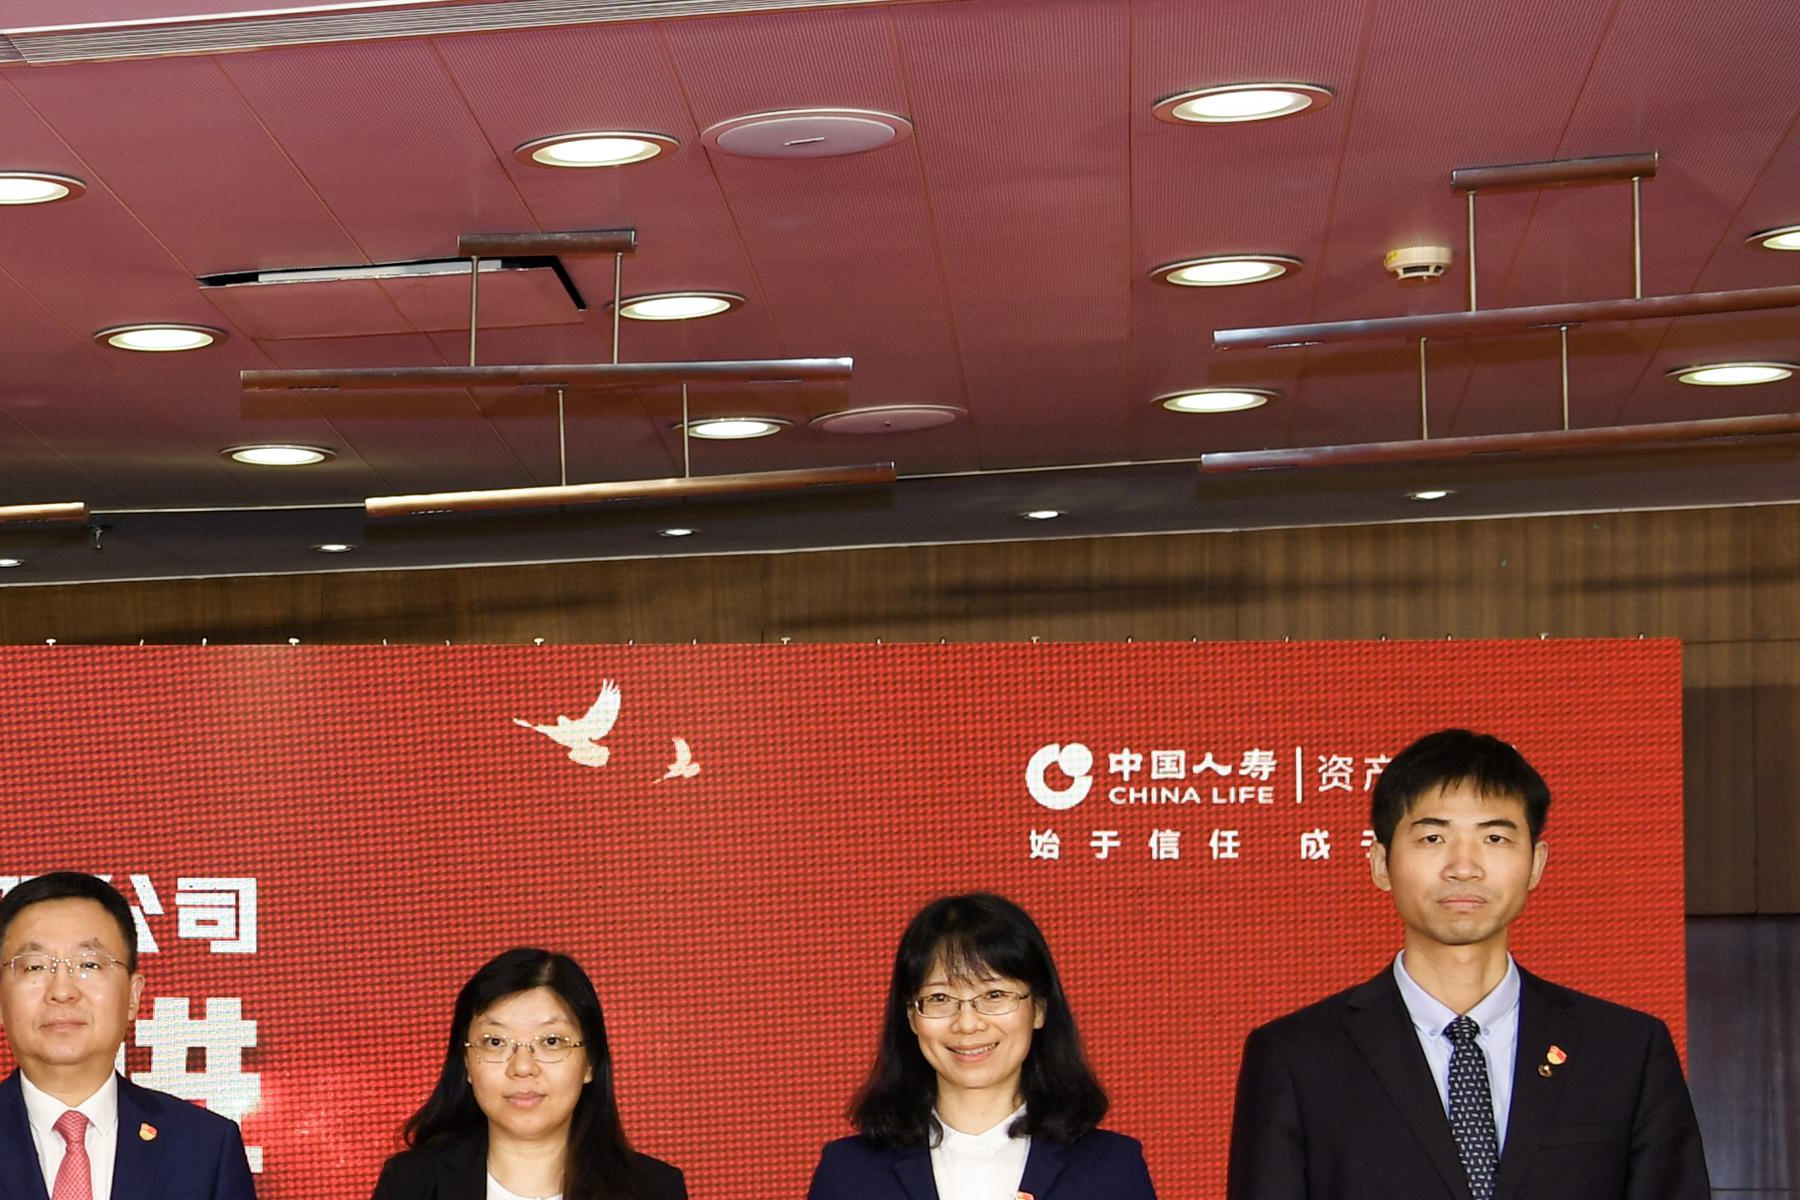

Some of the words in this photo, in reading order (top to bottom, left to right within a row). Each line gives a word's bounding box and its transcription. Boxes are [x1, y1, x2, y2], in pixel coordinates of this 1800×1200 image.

[1108, 748, 1278, 782] 中国人寿
[1108, 787, 1201, 805] CHINA
[1212, 787, 1275, 804] LIFE
[1029, 828, 1241, 861] 始于信任
